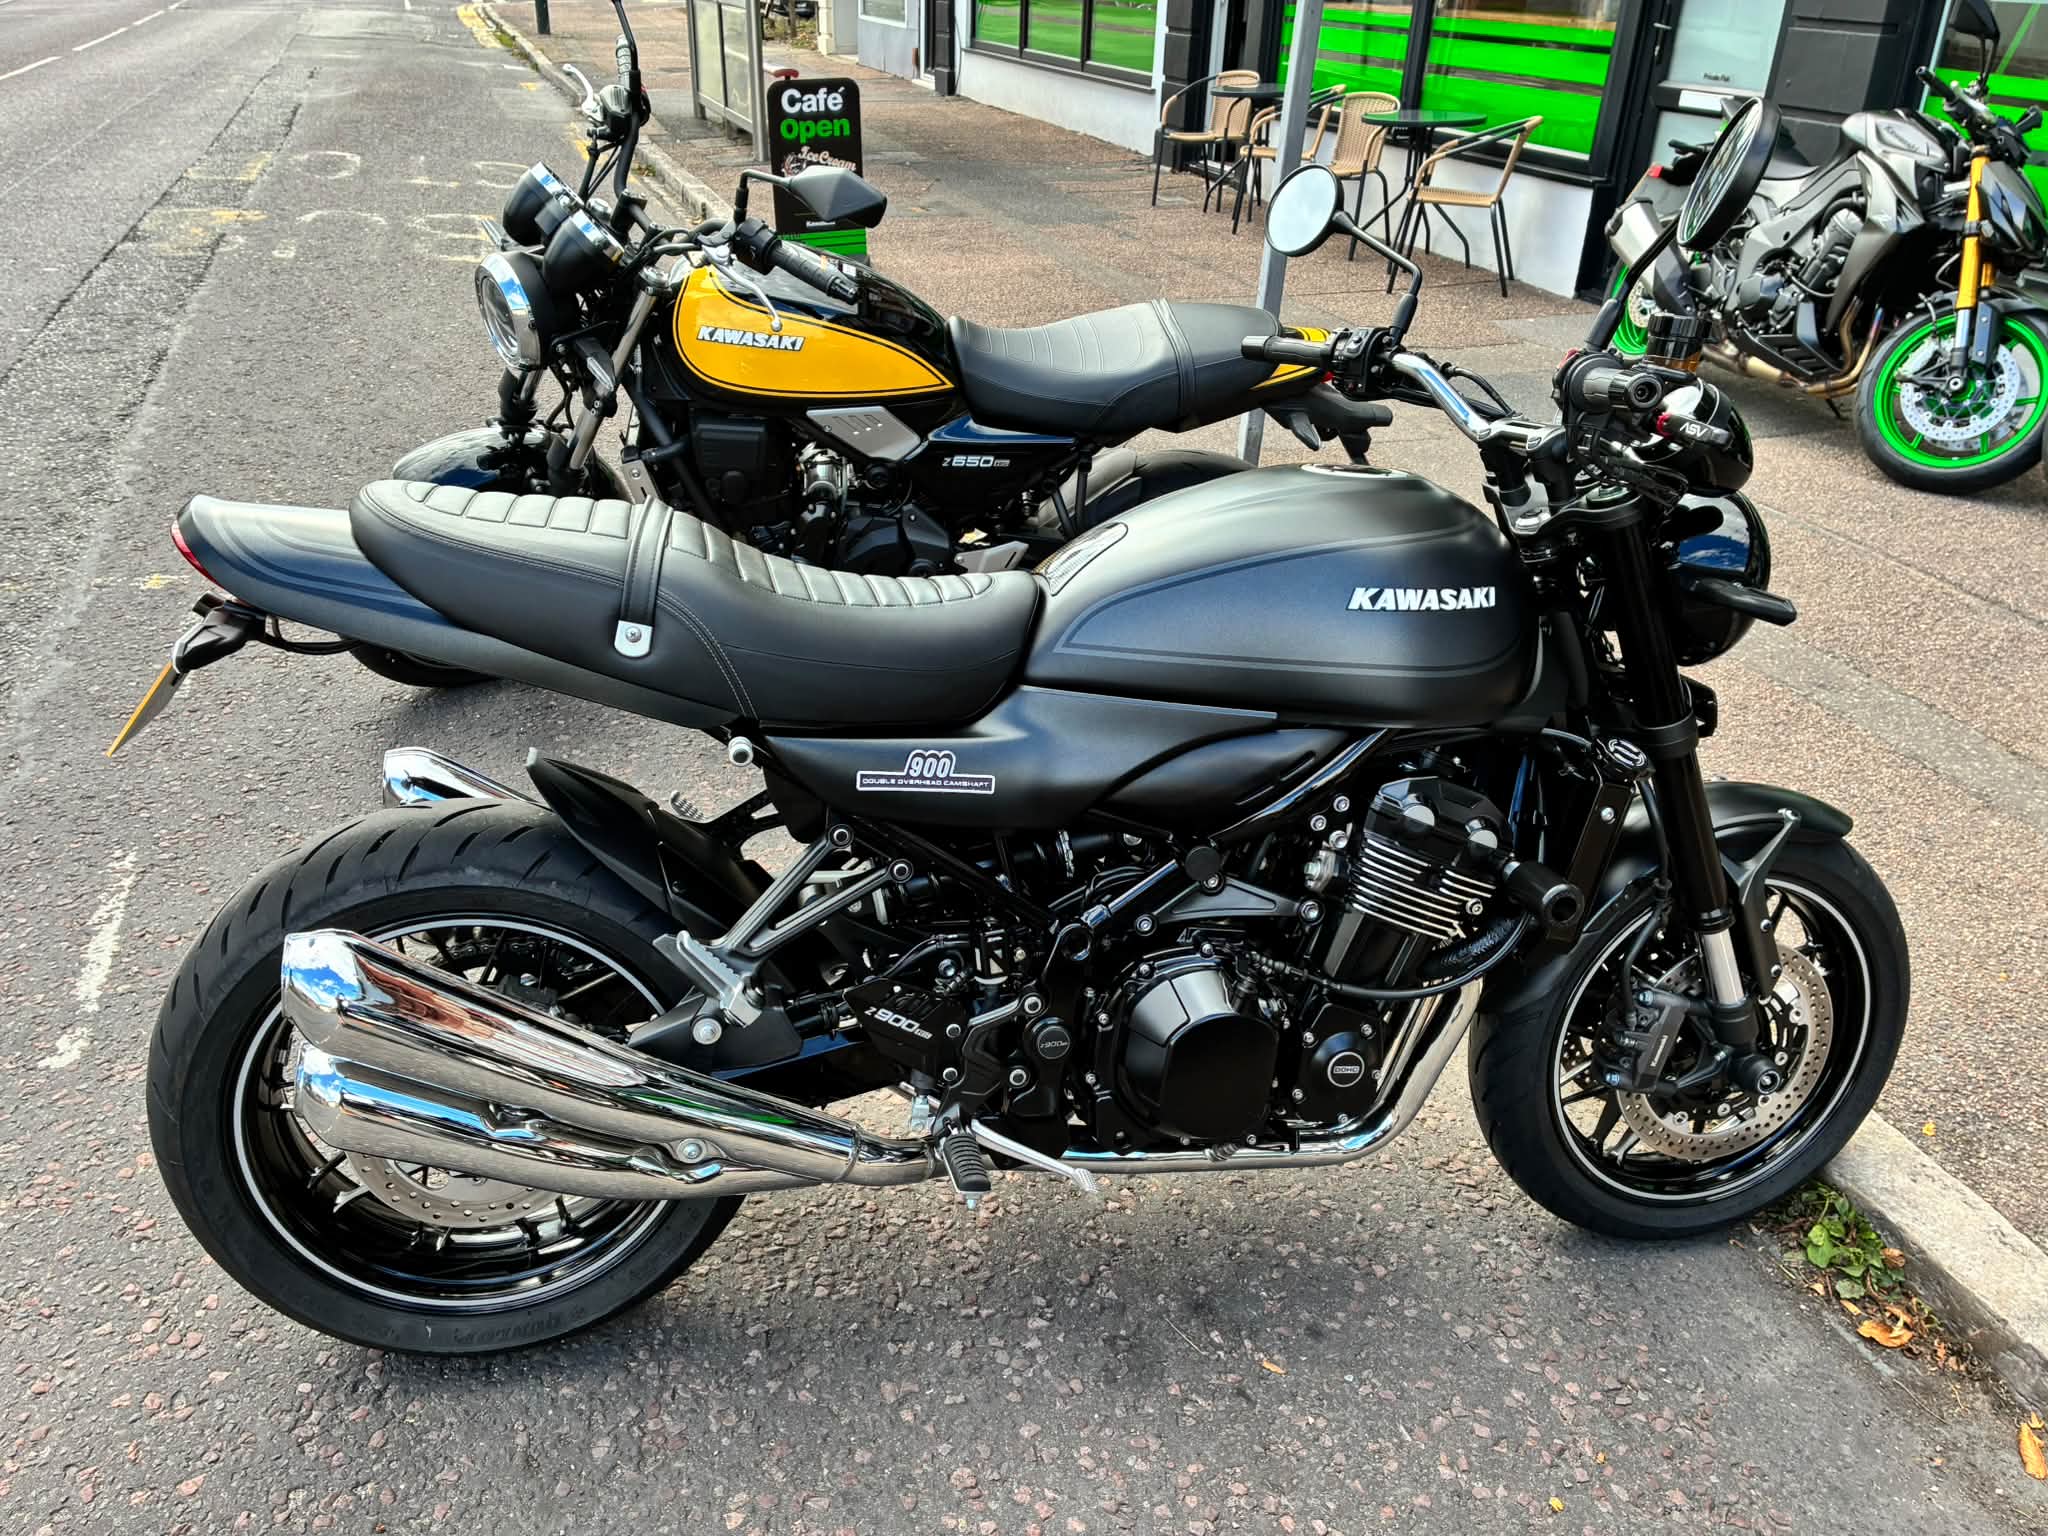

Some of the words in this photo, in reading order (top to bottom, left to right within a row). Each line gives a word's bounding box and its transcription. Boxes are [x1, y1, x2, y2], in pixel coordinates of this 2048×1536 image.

[781, 86, 845, 114] Café
[780, 118, 851, 143] Open
[697, 326, 805, 351] KAWASAKI
[1679, 422, 1708, 437] ASV
[1348, 586, 1497, 611] KAWASAKI
[909, 757, 951, 777] 900
